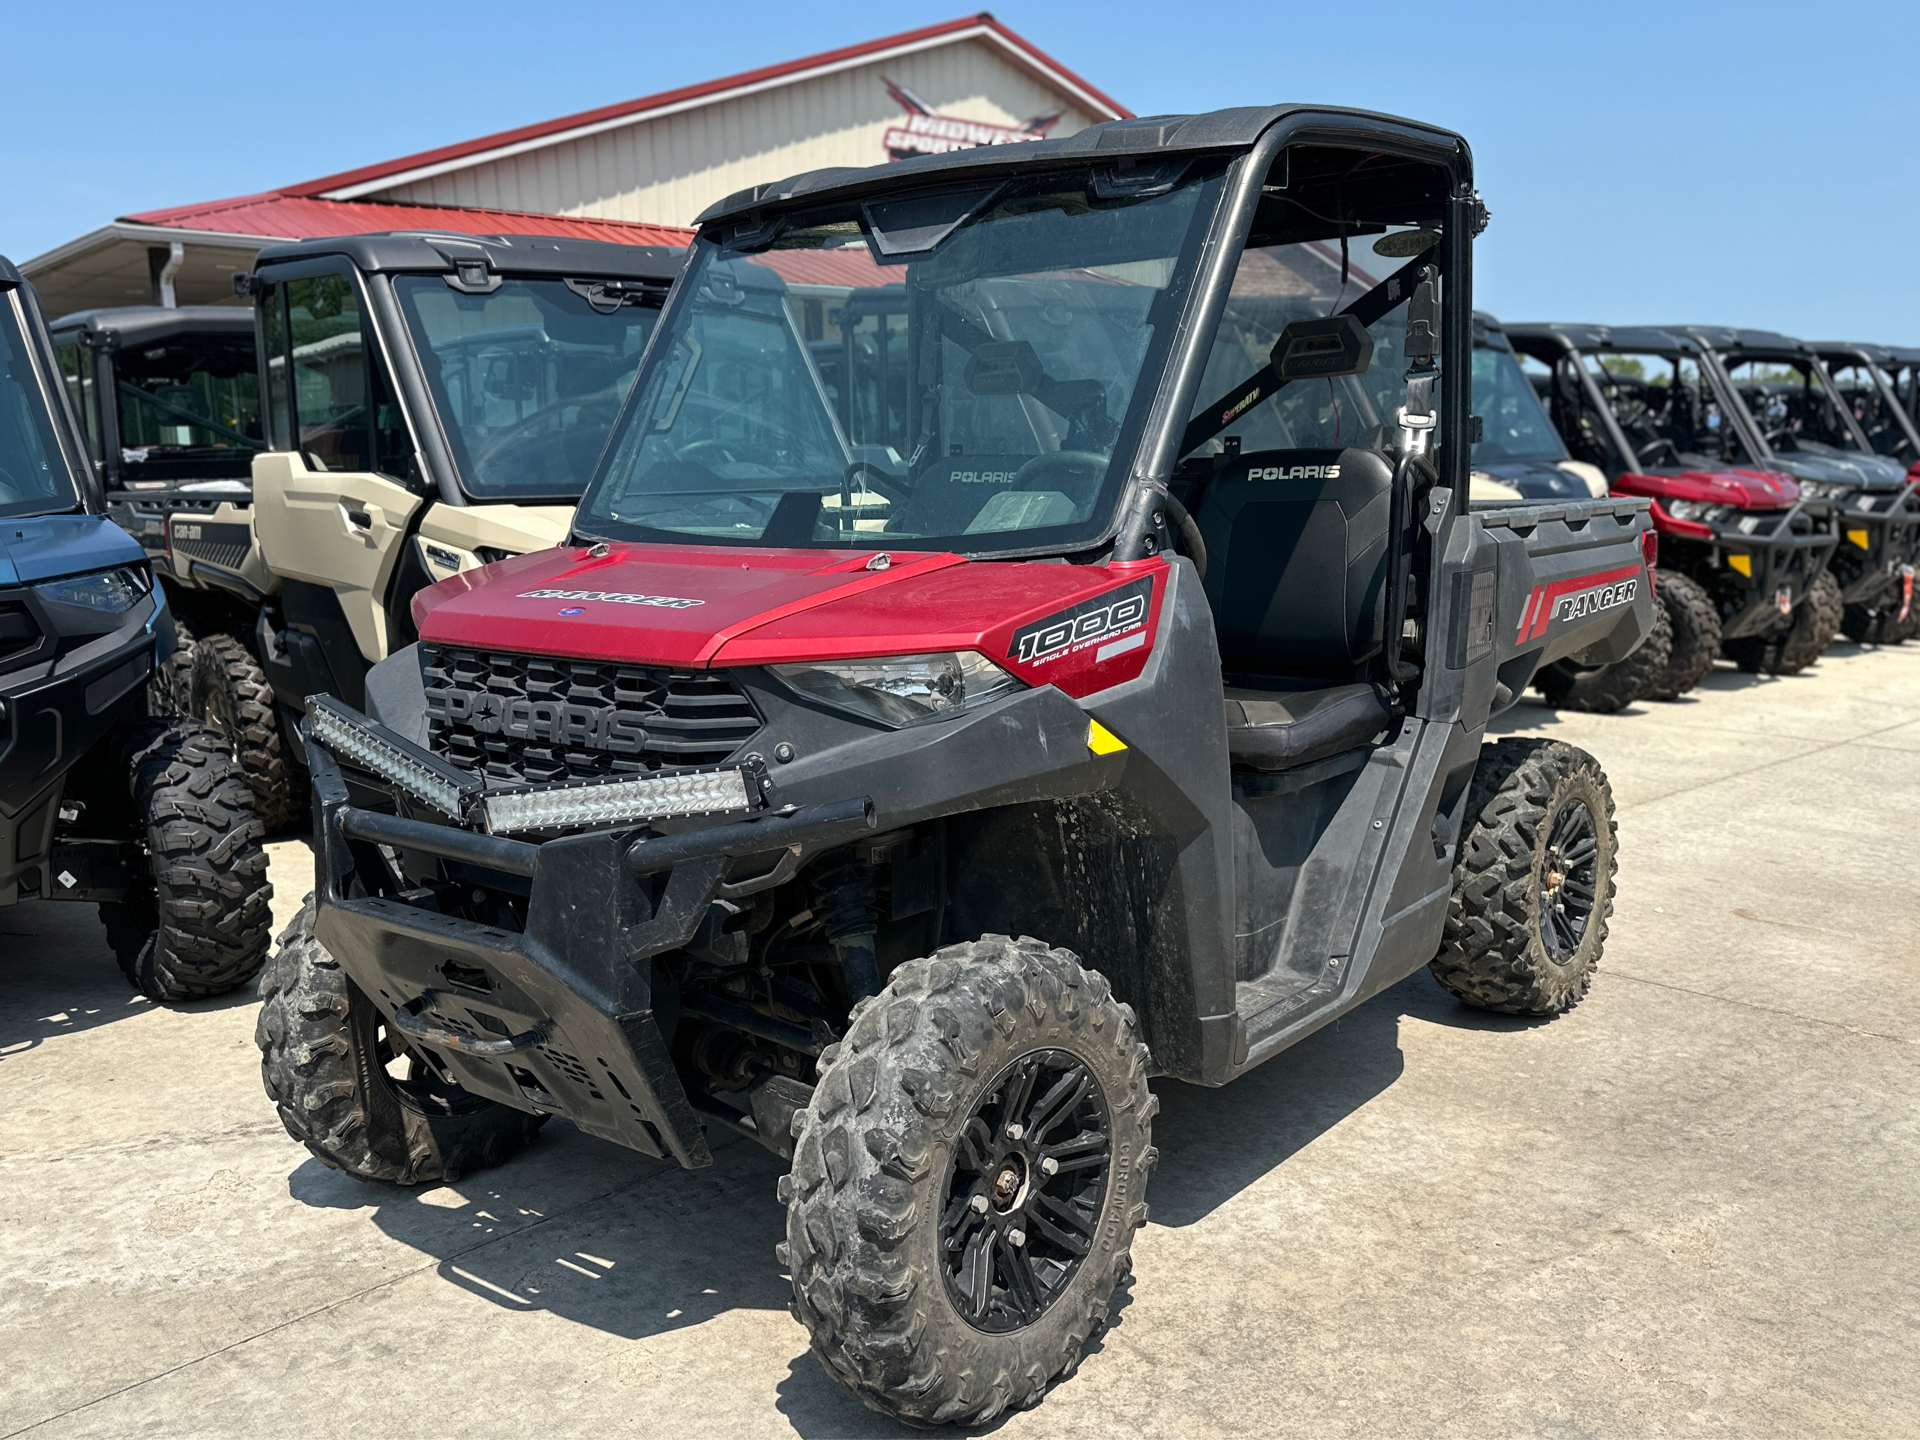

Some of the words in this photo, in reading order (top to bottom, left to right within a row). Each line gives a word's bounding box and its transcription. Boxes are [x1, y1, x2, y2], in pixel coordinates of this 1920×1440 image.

[950, 471, 1017, 483] POLARIS
[1247, 465, 1340, 481] POLARIS
[174, 525, 202, 540] can-am
[516, 589, 705, 608] RANGER
[1555, 579, 1637, 622] RANGER
[1018, 594, 1144, 663] 1000
[1032, 649, 1069, 667] SINGLE
[1072, 629, 1122, 652] OVERHEAD
[1122, 621, 1142, 633] CAM
[444, 688, 649, 753] POLARIS
[1101, 1142, 1130, 1252] CORONADO
